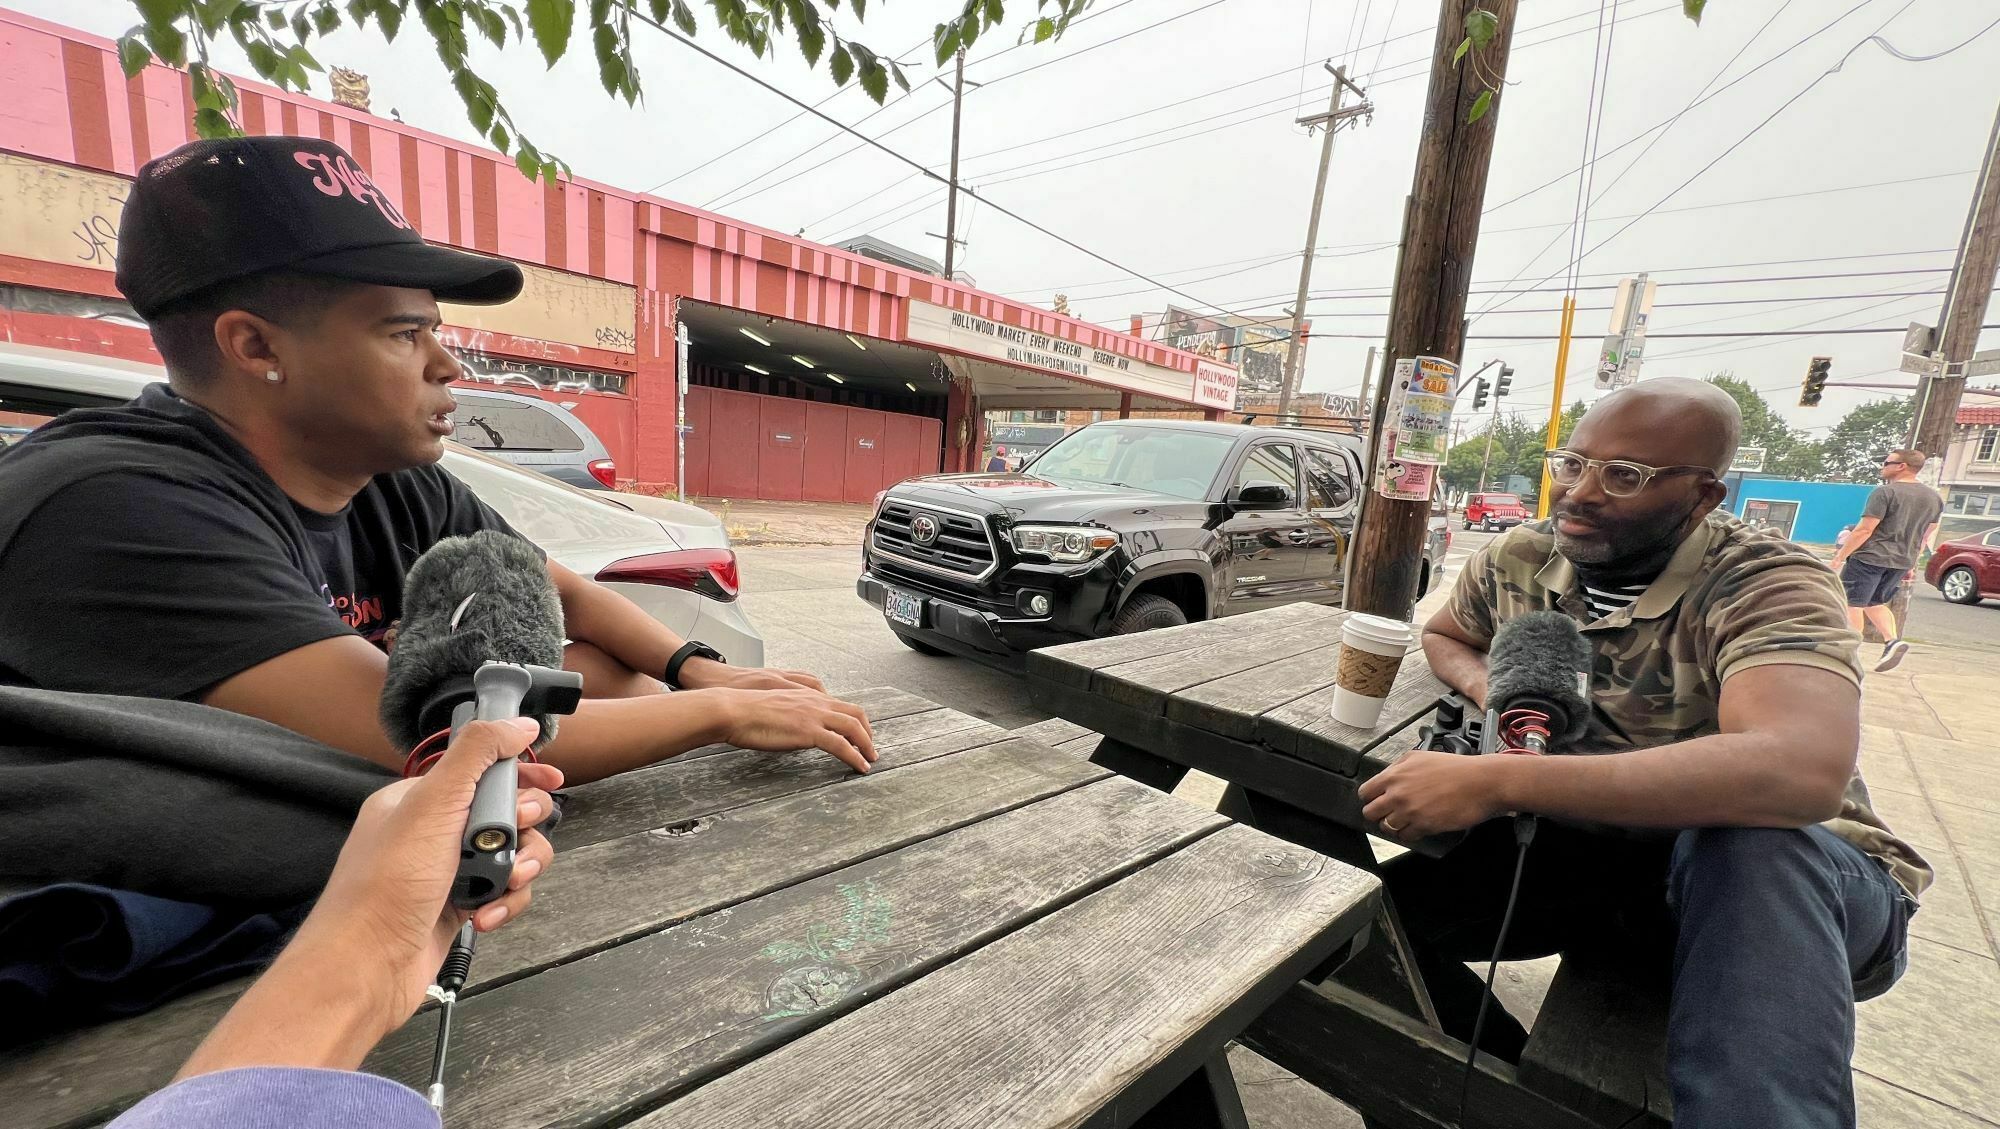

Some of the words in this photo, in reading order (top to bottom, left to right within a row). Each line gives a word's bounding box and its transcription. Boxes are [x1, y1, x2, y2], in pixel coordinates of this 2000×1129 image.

[952, 312, 994, 336] HOLLYWOOD
[998, 325, 1026, 344] MARKET
[1030, 334, 1050, 350] EVERY
[1054, 340, 1082, 358] WEEKEND
[1093, 351, 1115, 367] RESERVE
[1118, 357, 1129, 370] NOW
[1199, 368, 1236, 388] HOLLYWOOD
[1423, 378, 1447, 393] SALE
[1203, 385, 1229, 402] VINTAGE
[887, 595, 902, 614] 346
[906, 602, 920, 619] GNA
